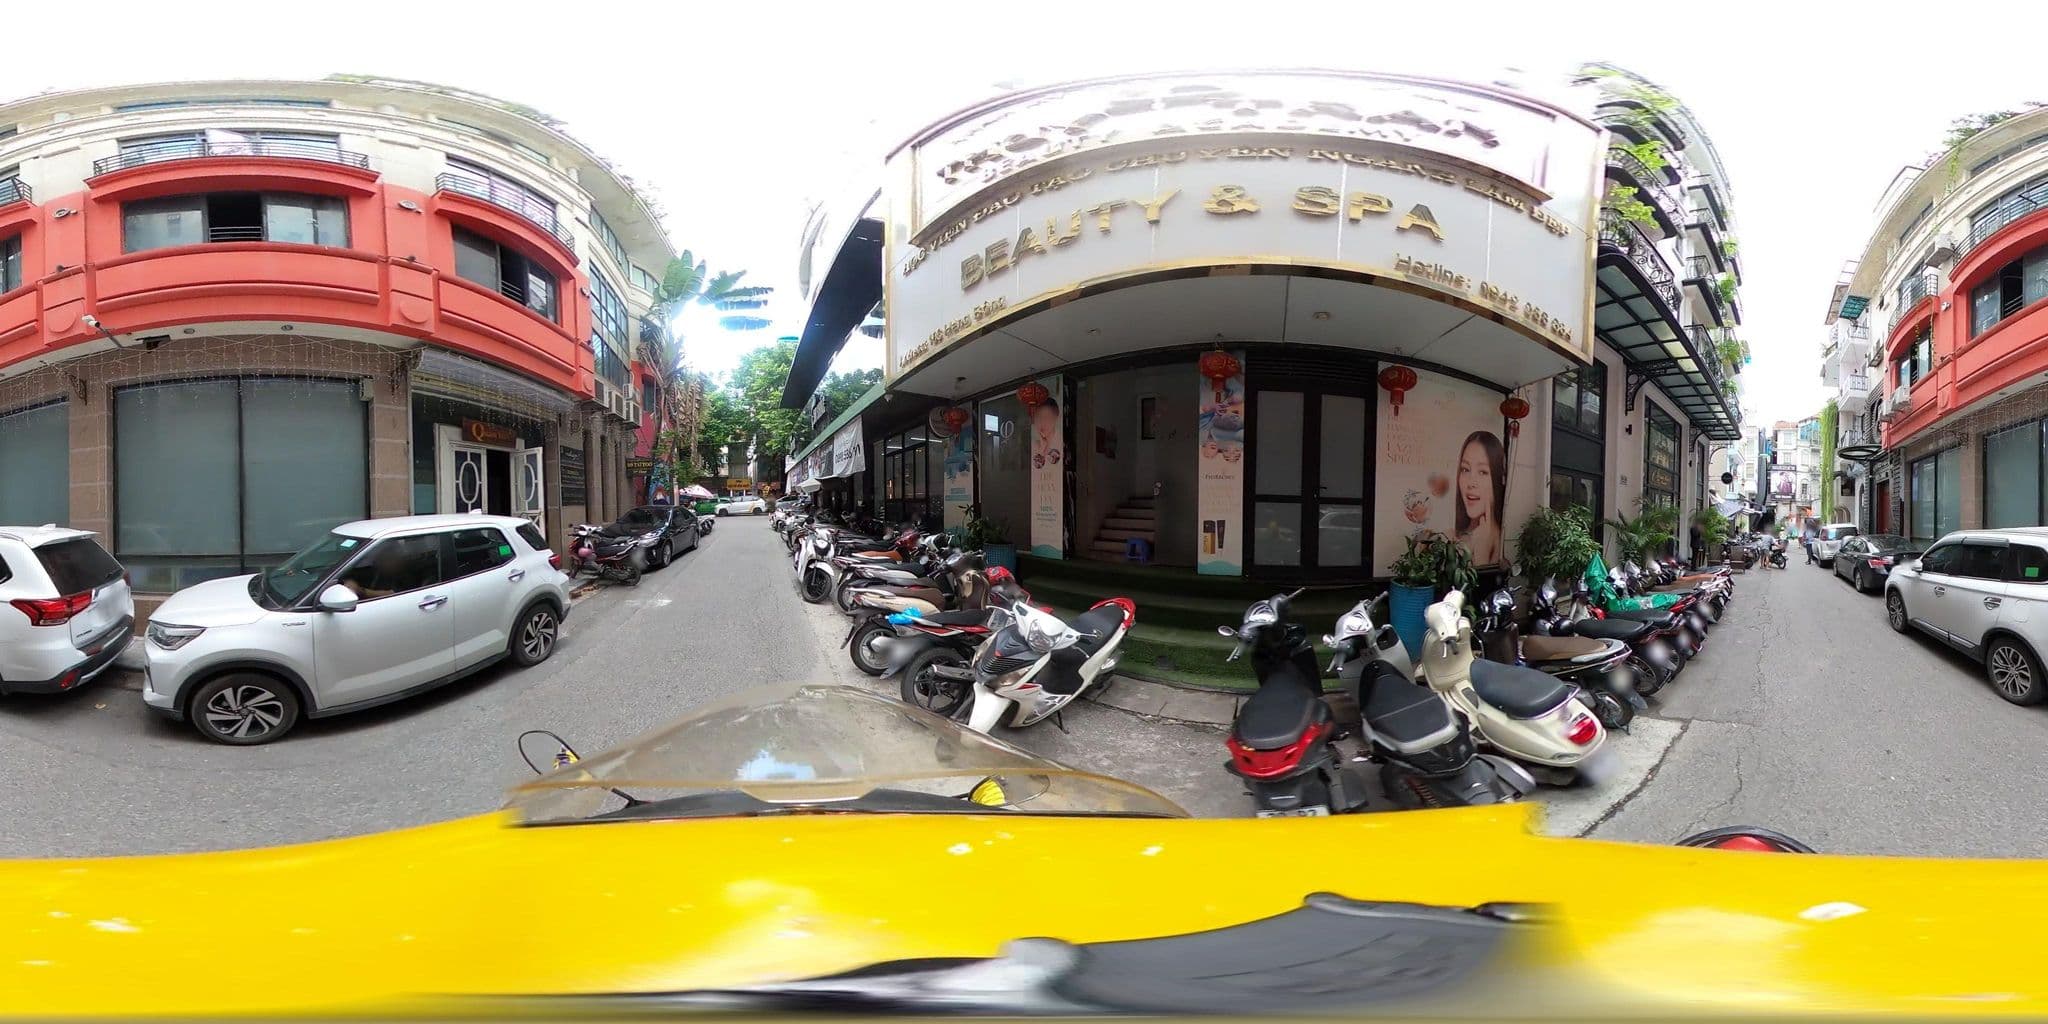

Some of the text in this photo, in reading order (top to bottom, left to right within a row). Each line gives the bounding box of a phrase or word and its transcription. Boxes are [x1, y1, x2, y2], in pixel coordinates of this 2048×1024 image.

[960, 184, 1445, 291] BEAUTY & SPA
